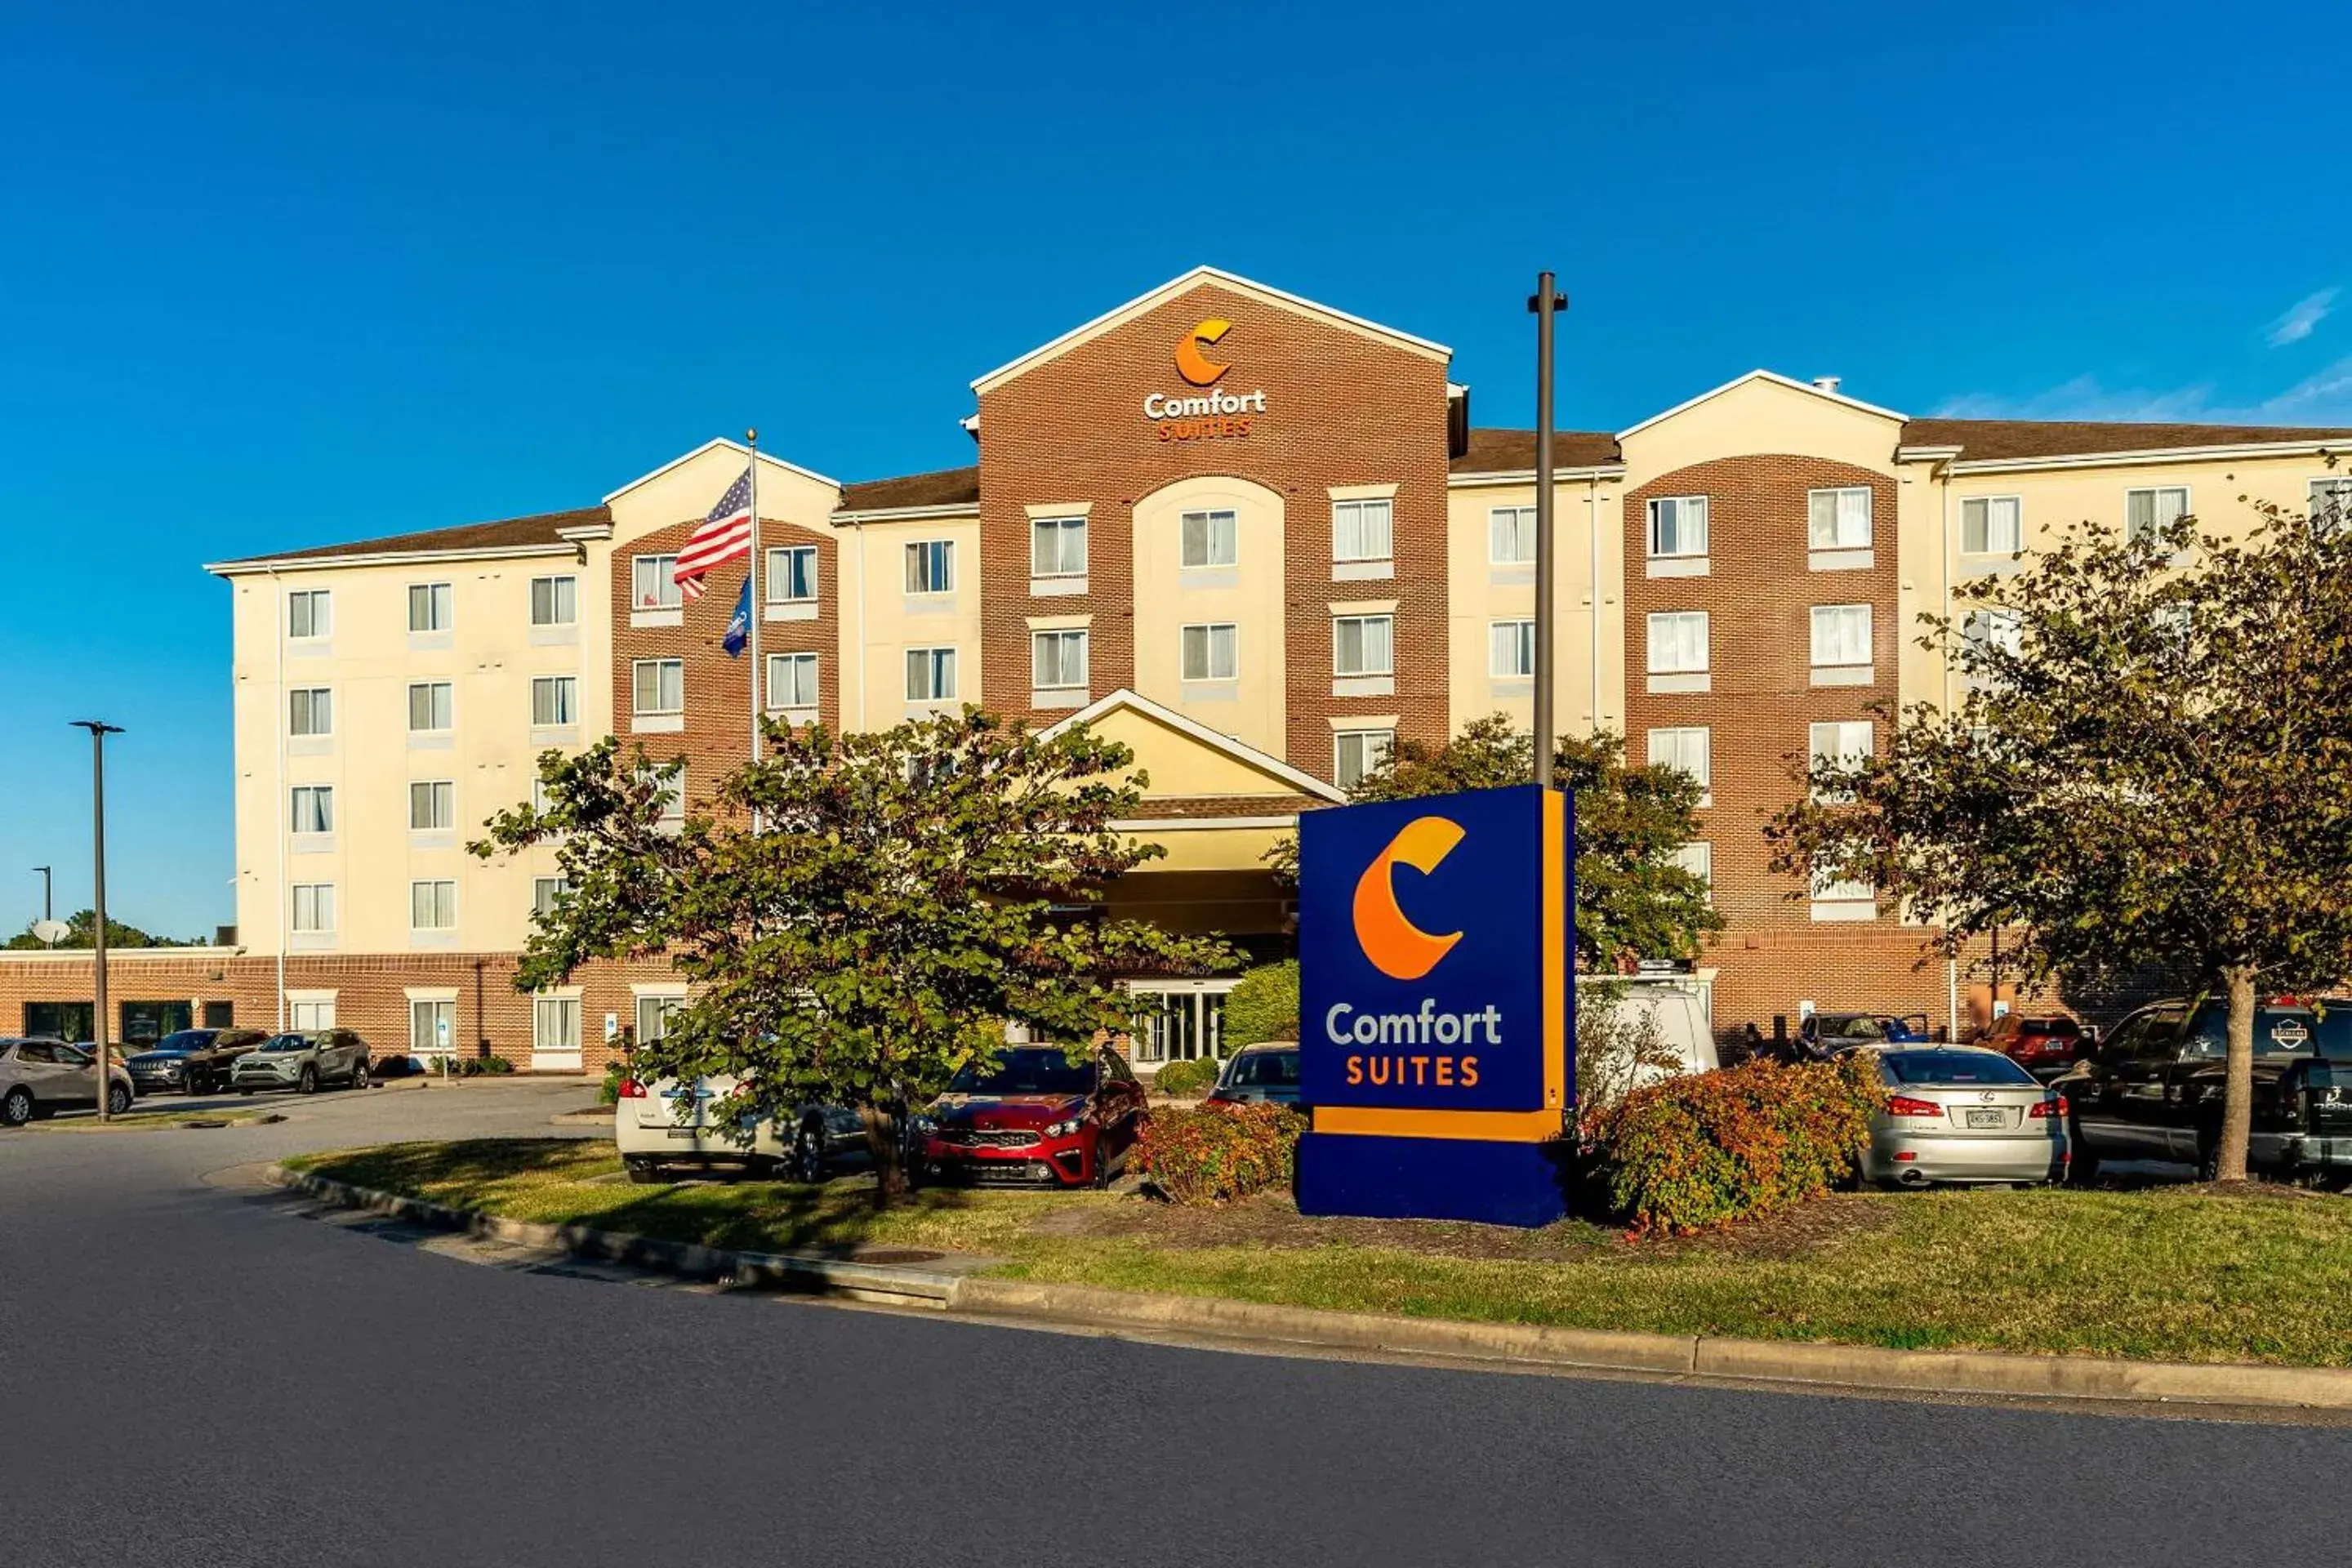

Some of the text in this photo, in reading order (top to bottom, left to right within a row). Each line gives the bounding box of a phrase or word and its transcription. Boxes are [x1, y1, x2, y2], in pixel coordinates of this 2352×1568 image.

[1143, 389, 1266, 419] Comfort
[1159, 417, 1251, 441] SUITES
[1325, 998, 1502, 1045] Comfort
[1346, 1055, 1480, 1088] SUITES
